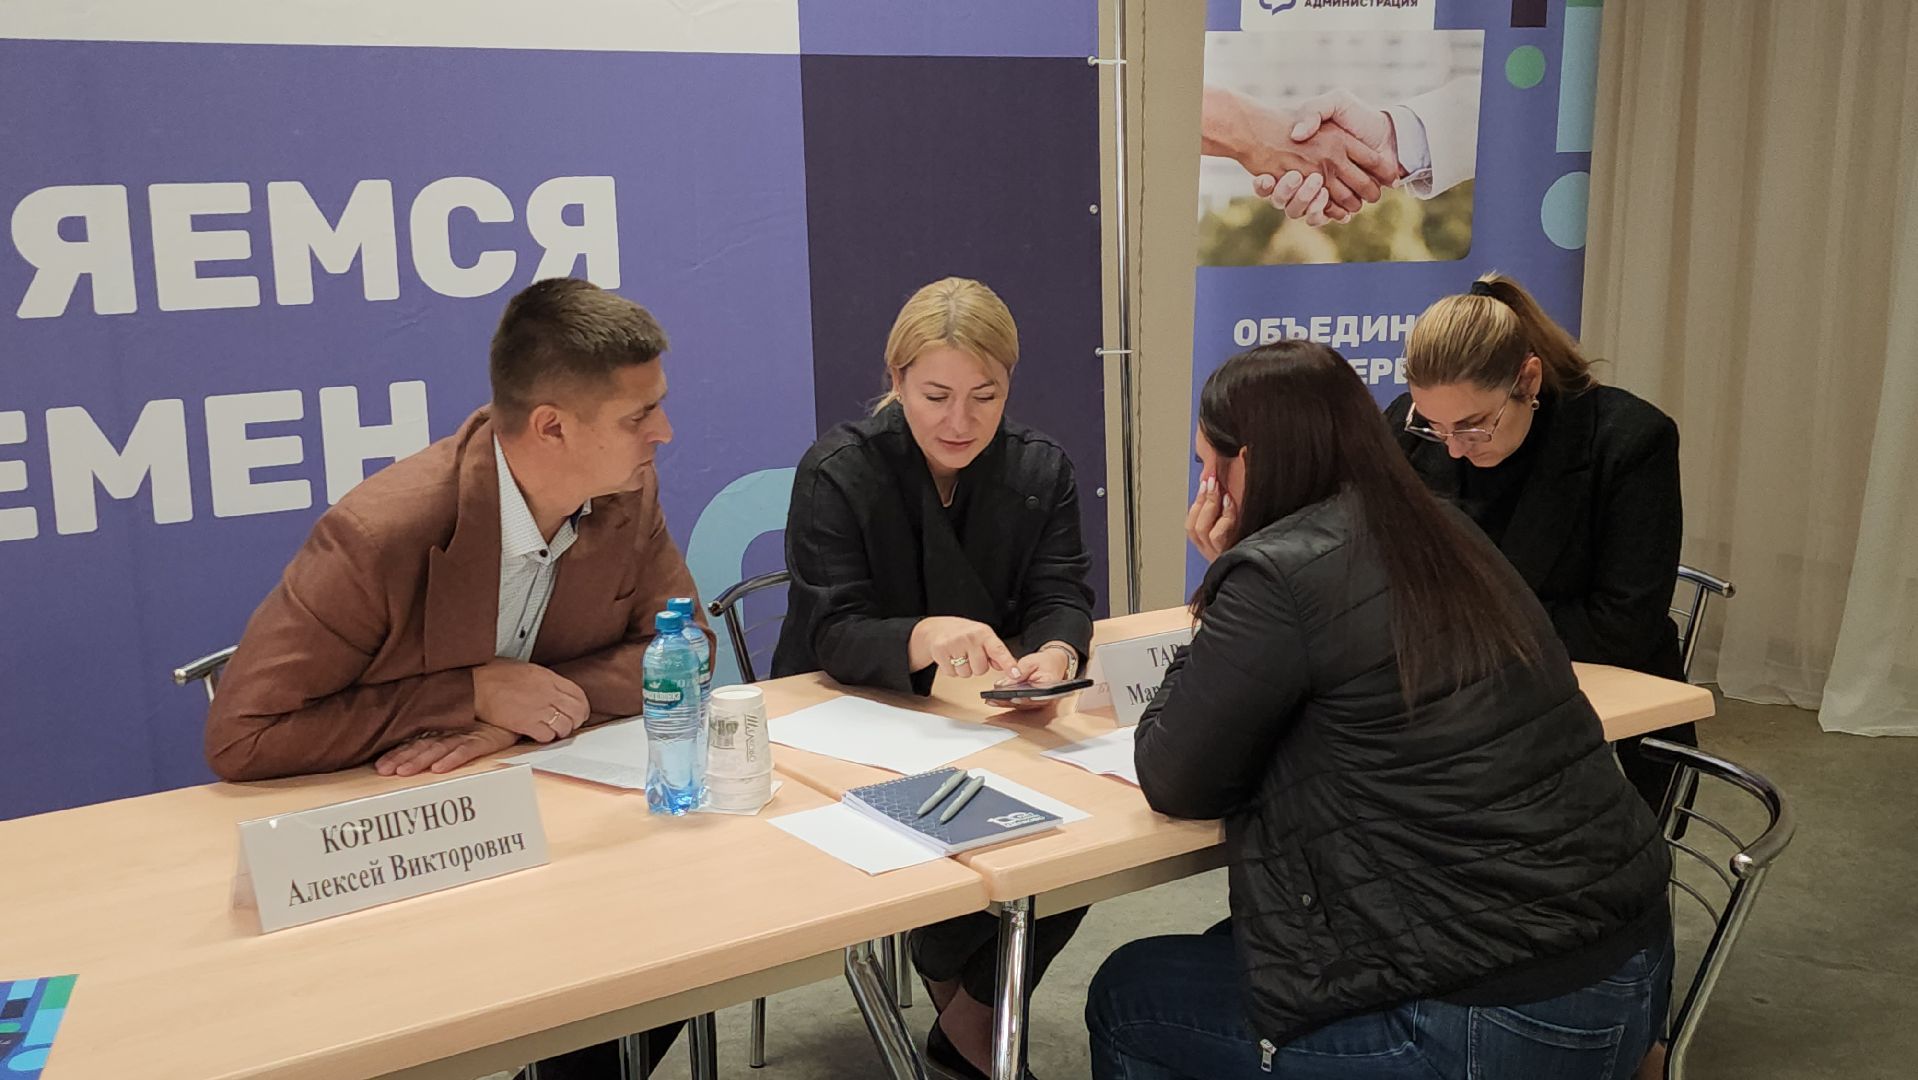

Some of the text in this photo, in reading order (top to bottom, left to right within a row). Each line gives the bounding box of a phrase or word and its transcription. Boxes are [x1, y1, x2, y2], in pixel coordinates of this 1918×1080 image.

[11, 176, 620, 318] ЯЕМСЯ
[1147, 642, 1182, 667] ТАР
[320, 795, 476, 854] КОРШУНОВ
[288, 832, 526, 907] Алексей Викторович
